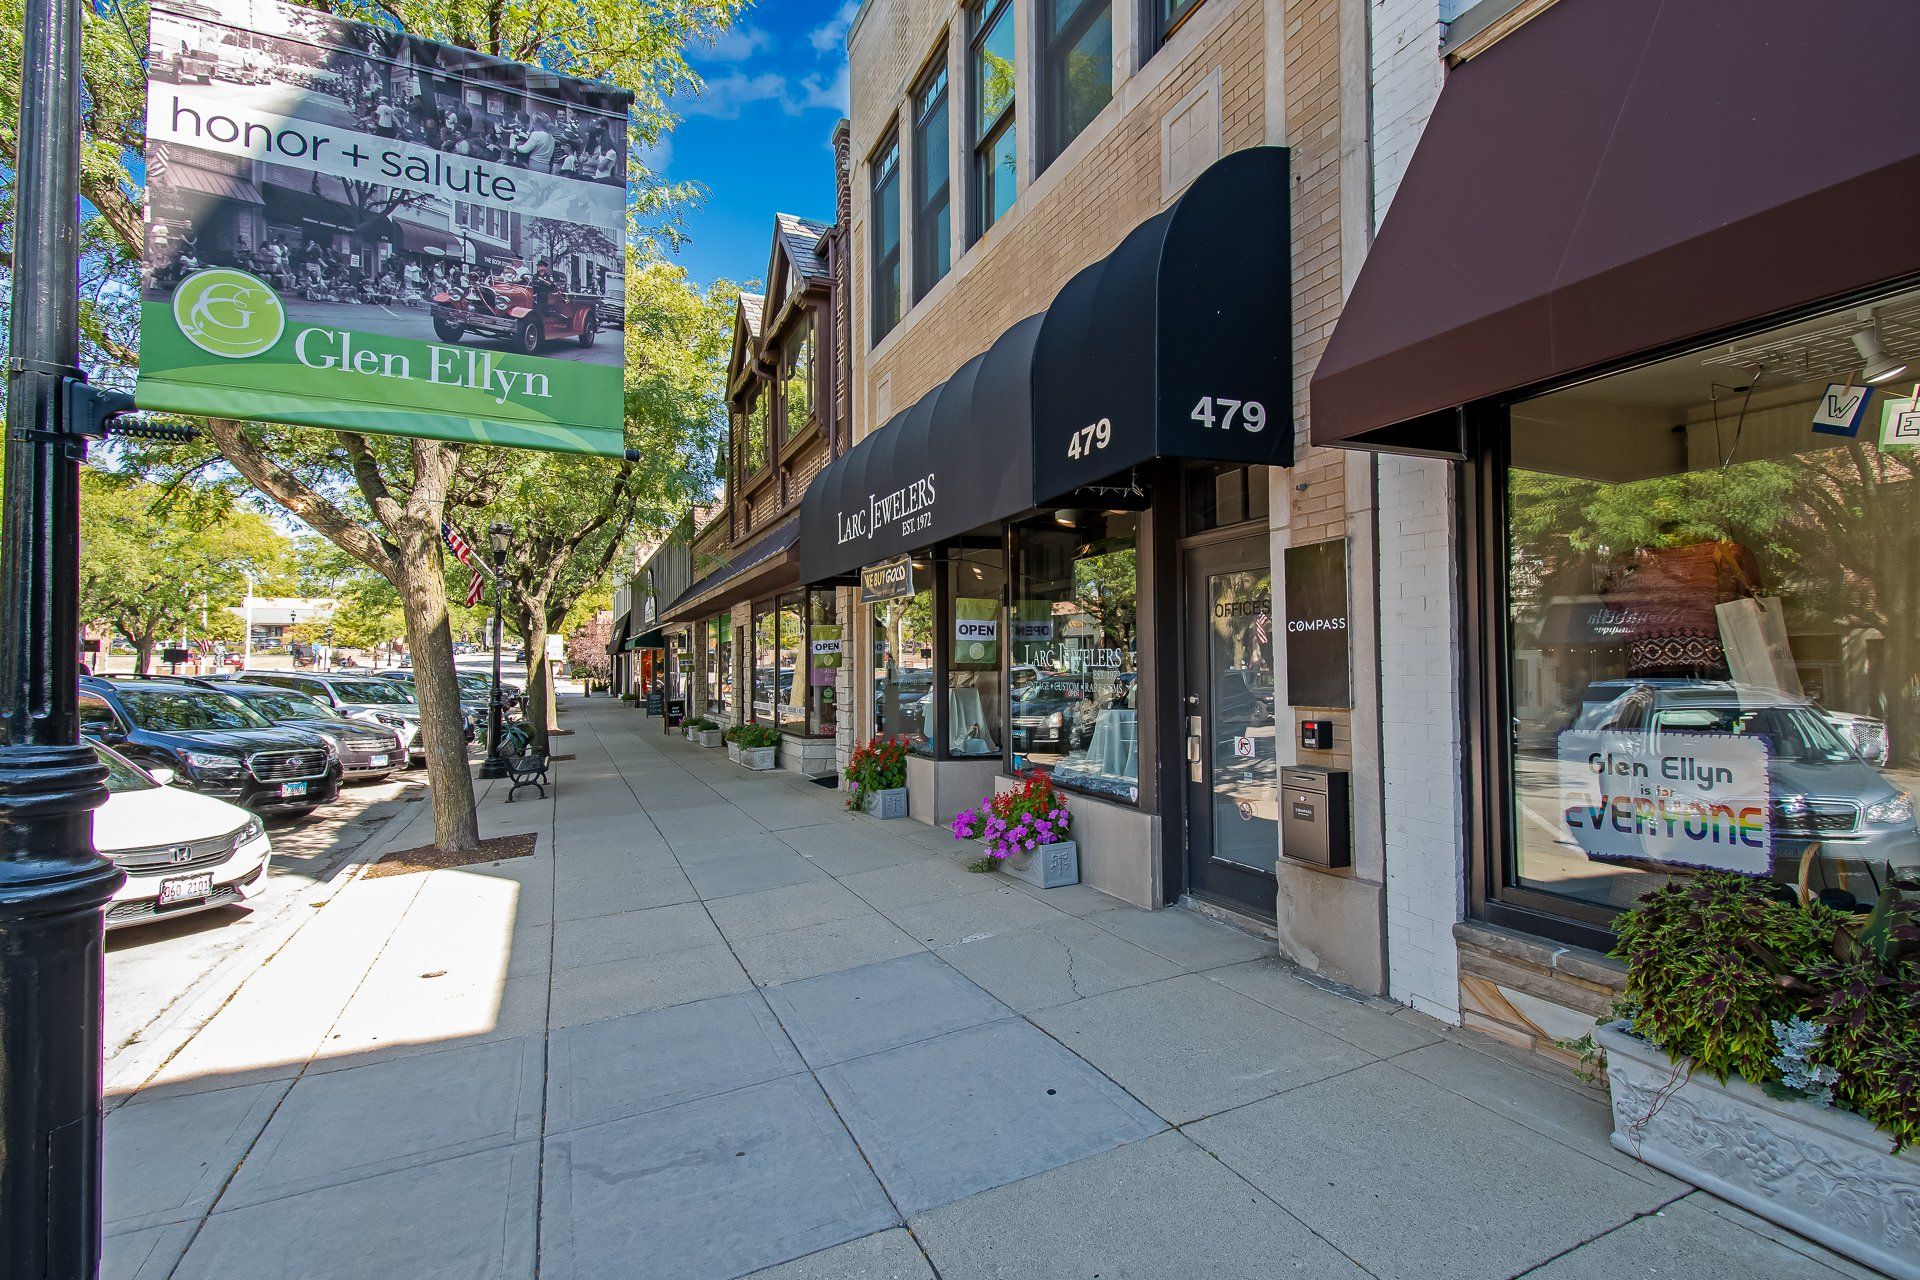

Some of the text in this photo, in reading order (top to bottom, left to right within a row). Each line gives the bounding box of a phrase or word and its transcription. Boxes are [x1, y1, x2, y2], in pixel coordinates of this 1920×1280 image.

[172, 95, 330, 161] honor
[380, 153, 517, 201] salute
[294, 327, 553, 404] Glen Ellyn
[1190, 396, 1266, 433] 479
[1828, 394, 1860, 419] W
[1067, 417, 1111, 460] 479
[902, 511, 932, 537] EST. 1972
[865, 565, 906, 589] WE BUY GOLD
[1214, 599, 1271, 619] OFFICES
[958, 624, 995, 636] OPEN
[1287, 617, 1347, 633] COMPASS
[815, 643, 840, 651] OPEN
[1054, 681, 1081, 692] CUSTOM
[1588, 752, 1733, 791] Glen Ellyn
[1640, 784, 1676, 797] is for
[1565, 792, 1764, 848] EVERYONE
[187, 880, 209, 895] 2101
